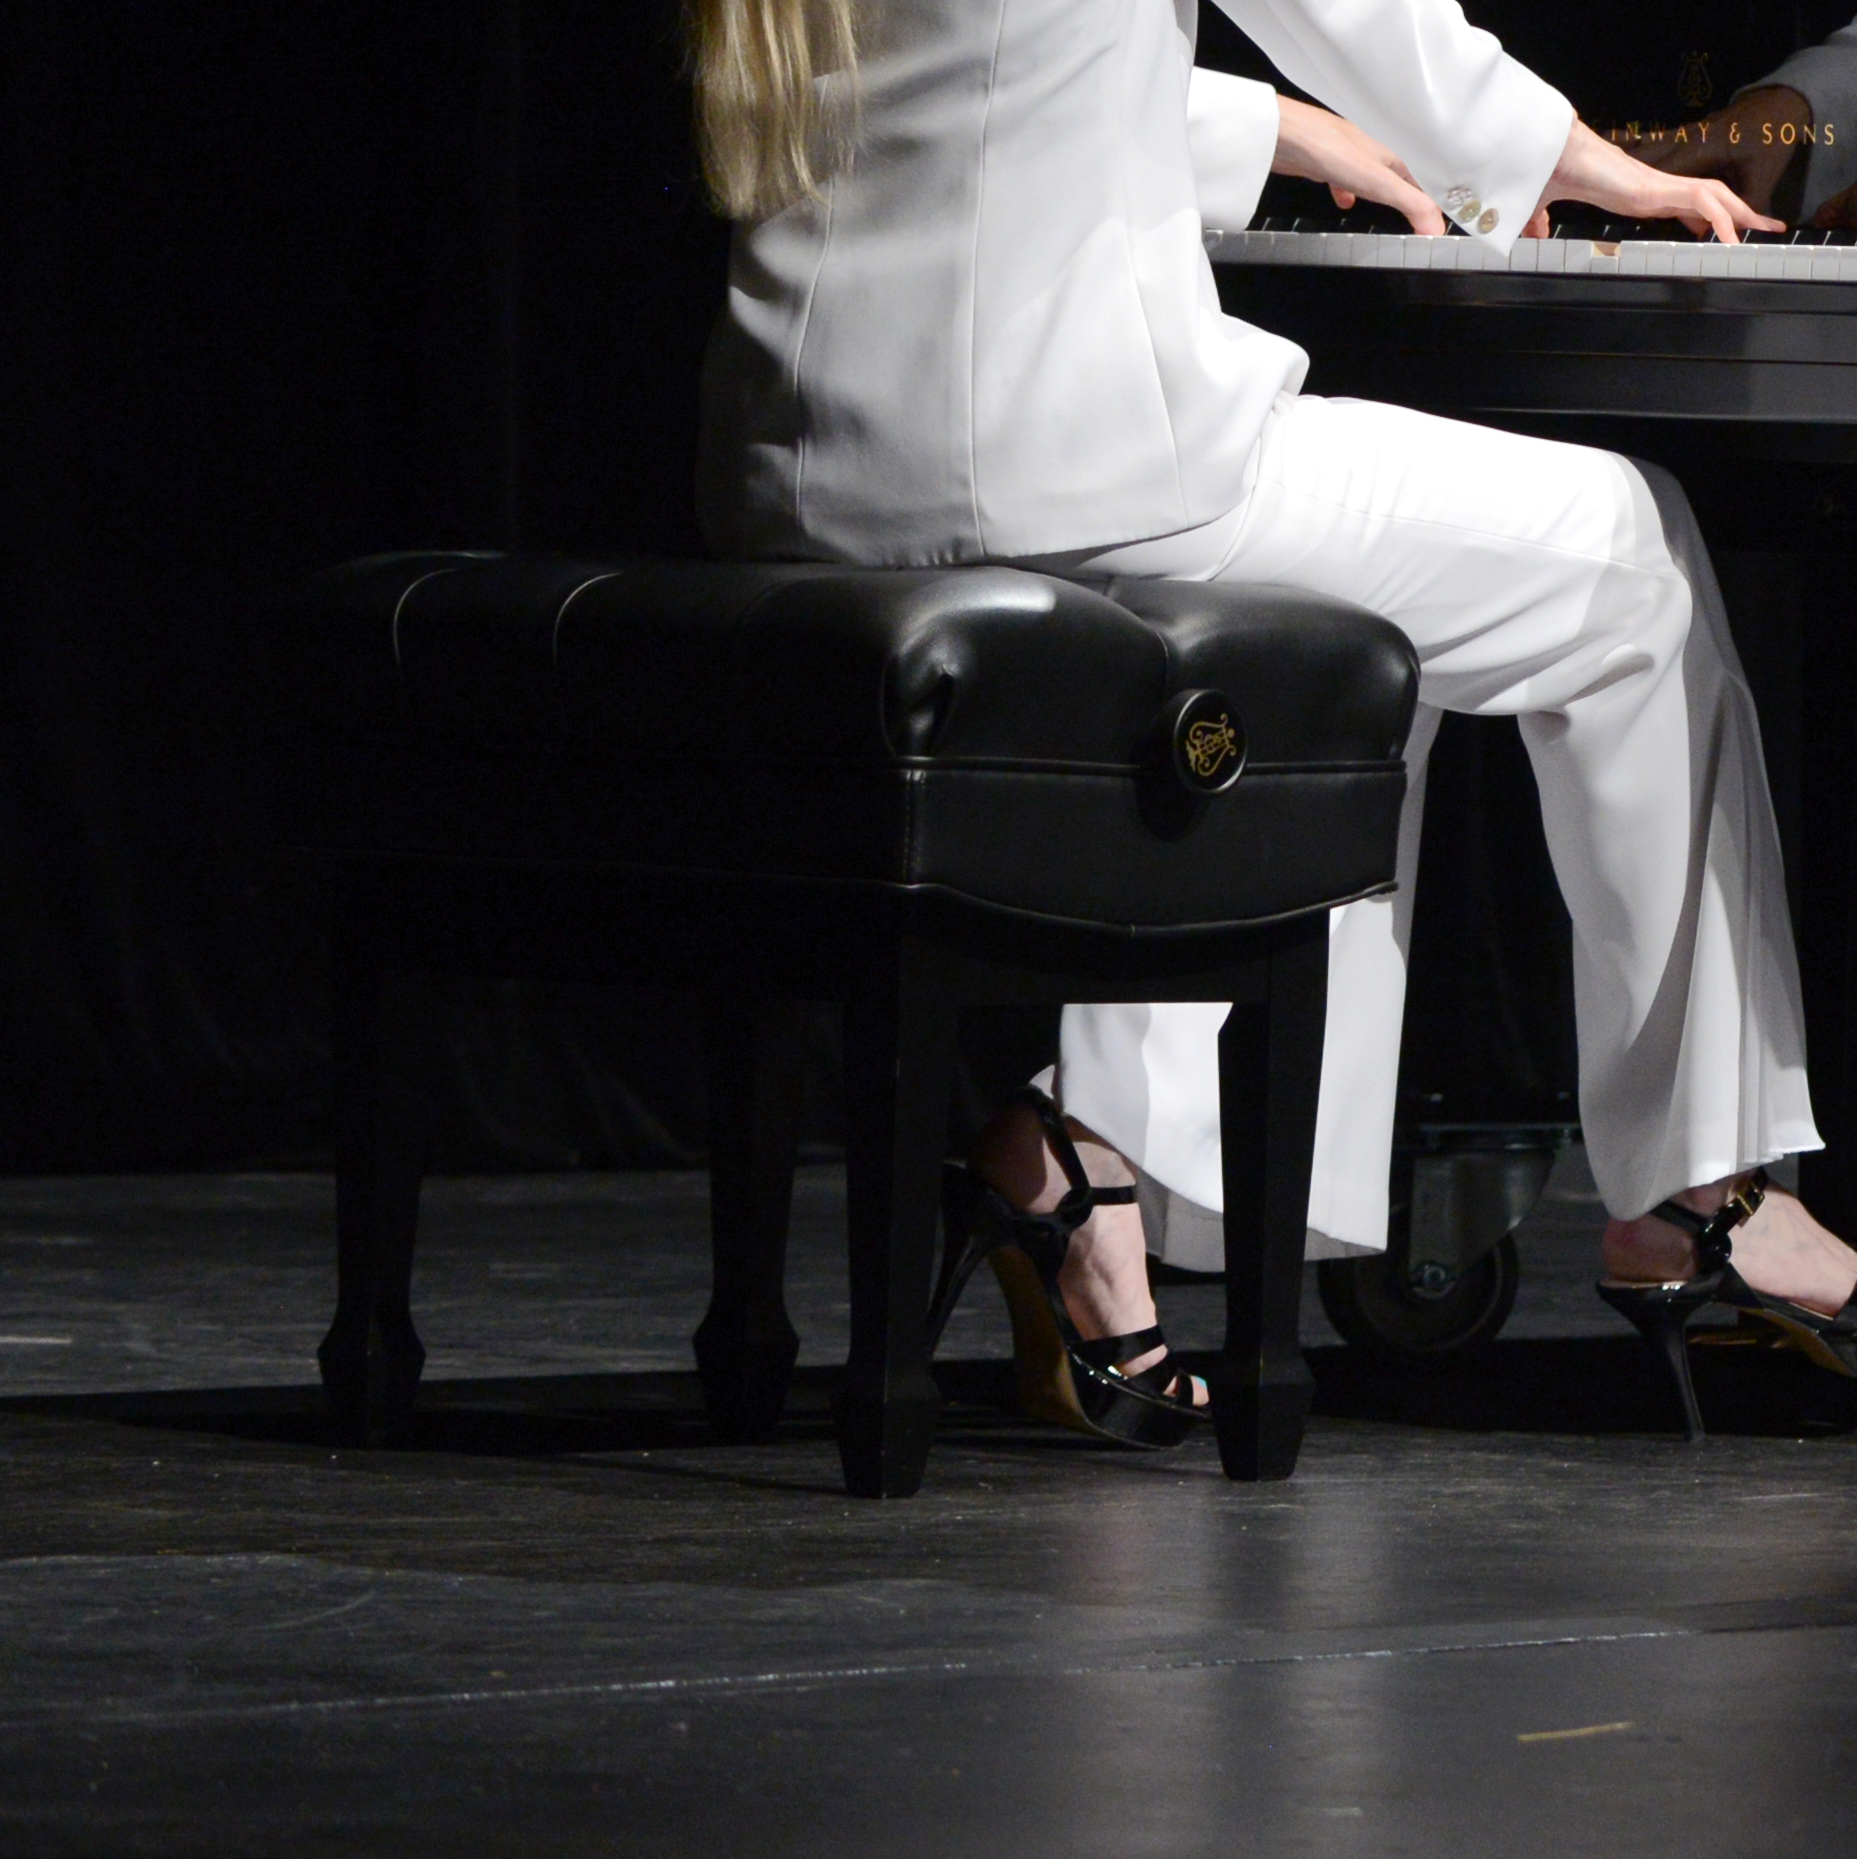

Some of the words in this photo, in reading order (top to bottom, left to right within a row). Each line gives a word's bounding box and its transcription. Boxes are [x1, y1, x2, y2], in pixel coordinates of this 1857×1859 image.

[1594, 120, 1710, 143] INWAY
[1729, 121, 1741, 144] &
[1762, 122, 1835, 146] SONS
